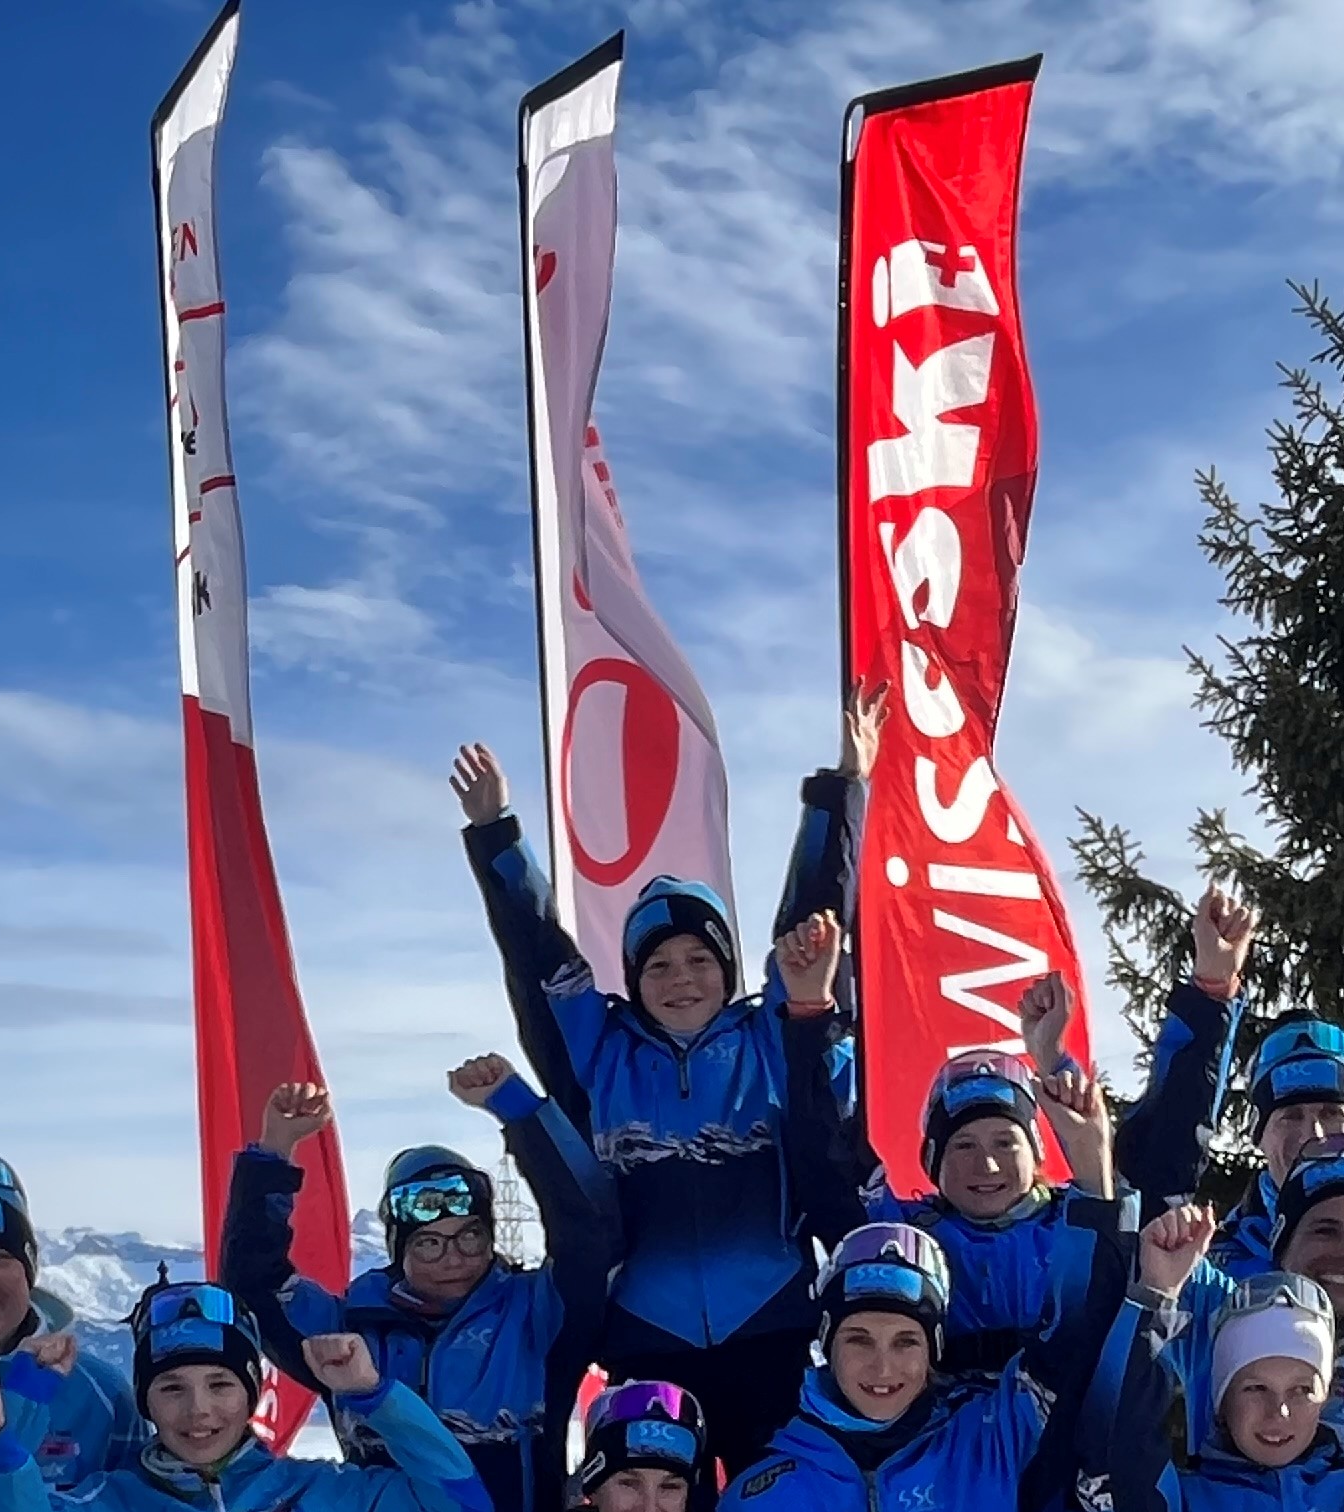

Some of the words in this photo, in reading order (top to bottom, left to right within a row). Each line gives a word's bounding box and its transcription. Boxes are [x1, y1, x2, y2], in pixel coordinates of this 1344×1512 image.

[856, 1267, 892, 1281] SSC
[640, 1421, 675, 1441] SSC
[898, 1483, 935, 1509] SSC
